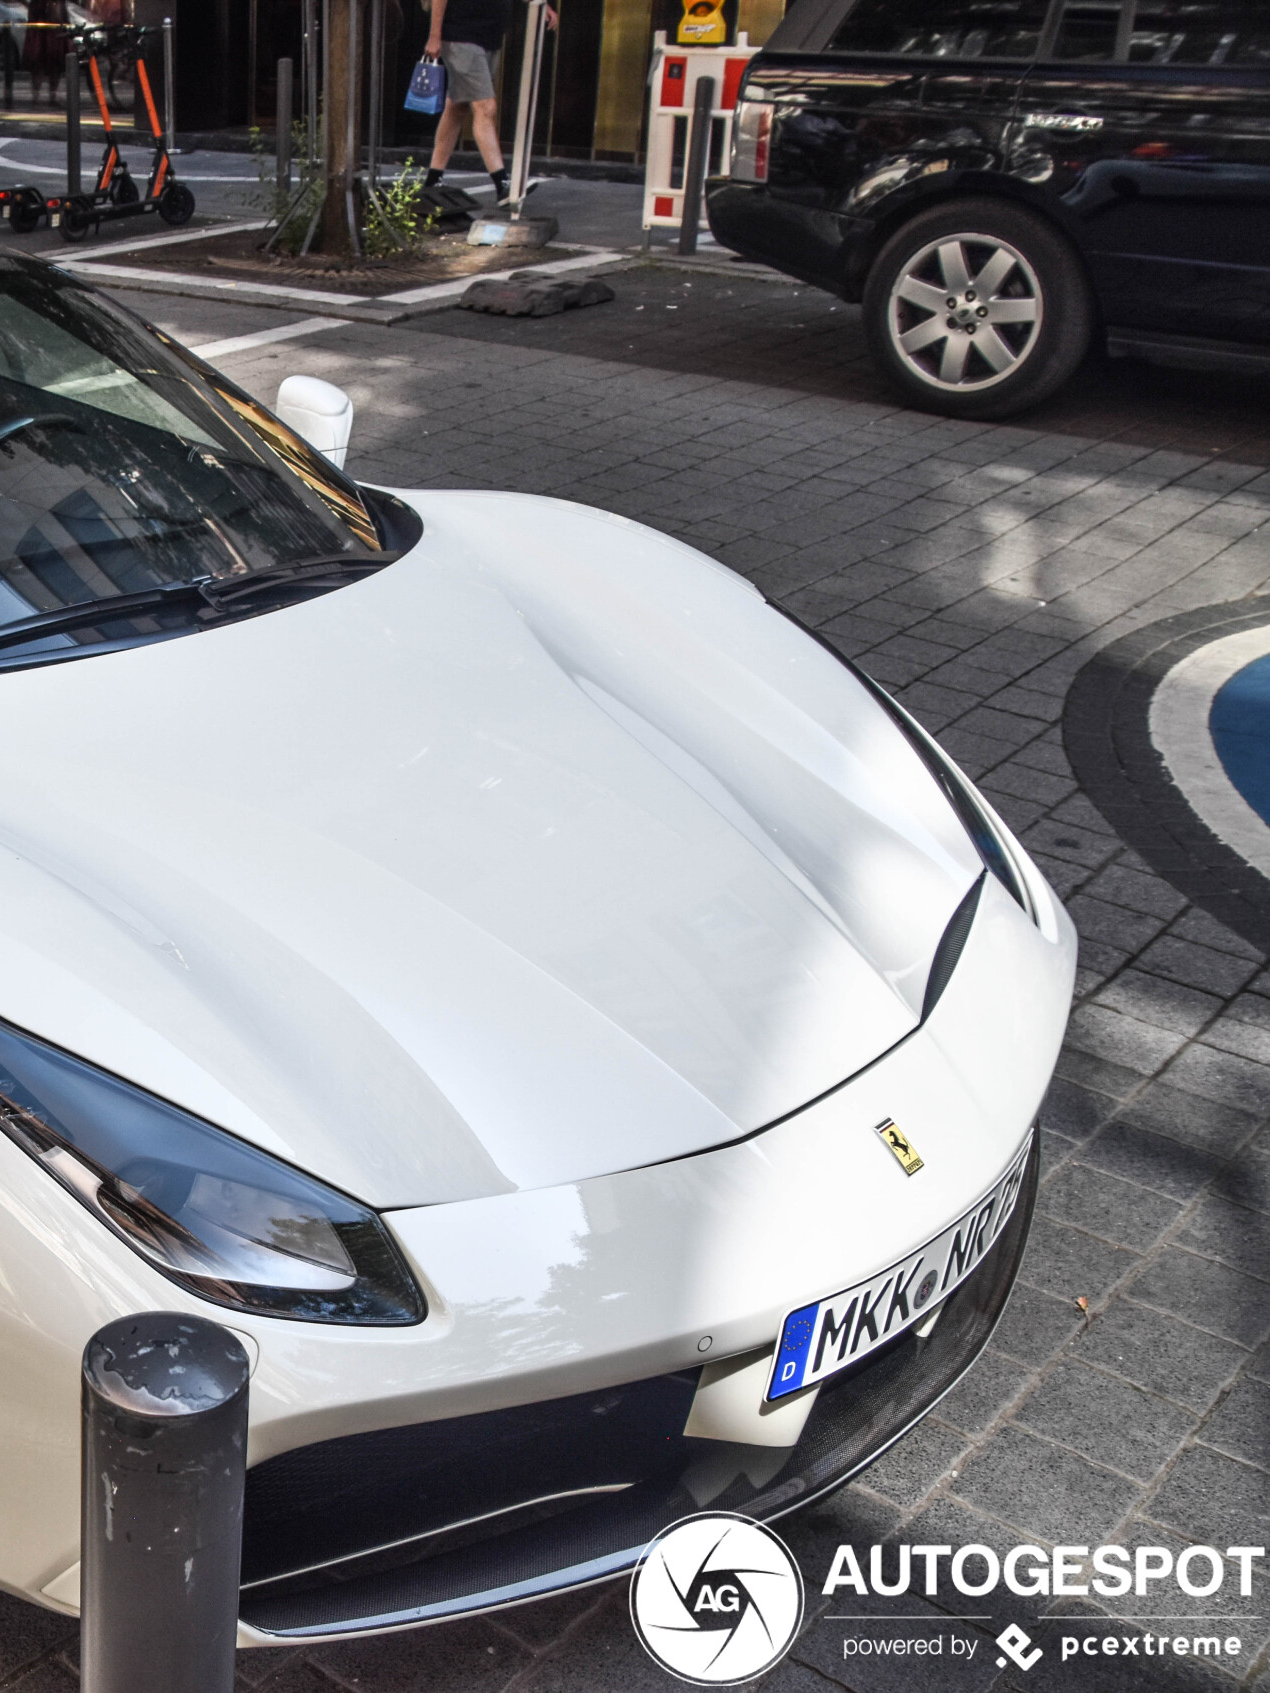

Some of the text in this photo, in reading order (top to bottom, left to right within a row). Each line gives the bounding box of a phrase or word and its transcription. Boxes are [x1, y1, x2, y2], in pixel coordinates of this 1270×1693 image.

[812, 1256, 925, 1374] MKK
[941, 1197, 996, 1293] NR
[781, 1361, 797, 1382] D
